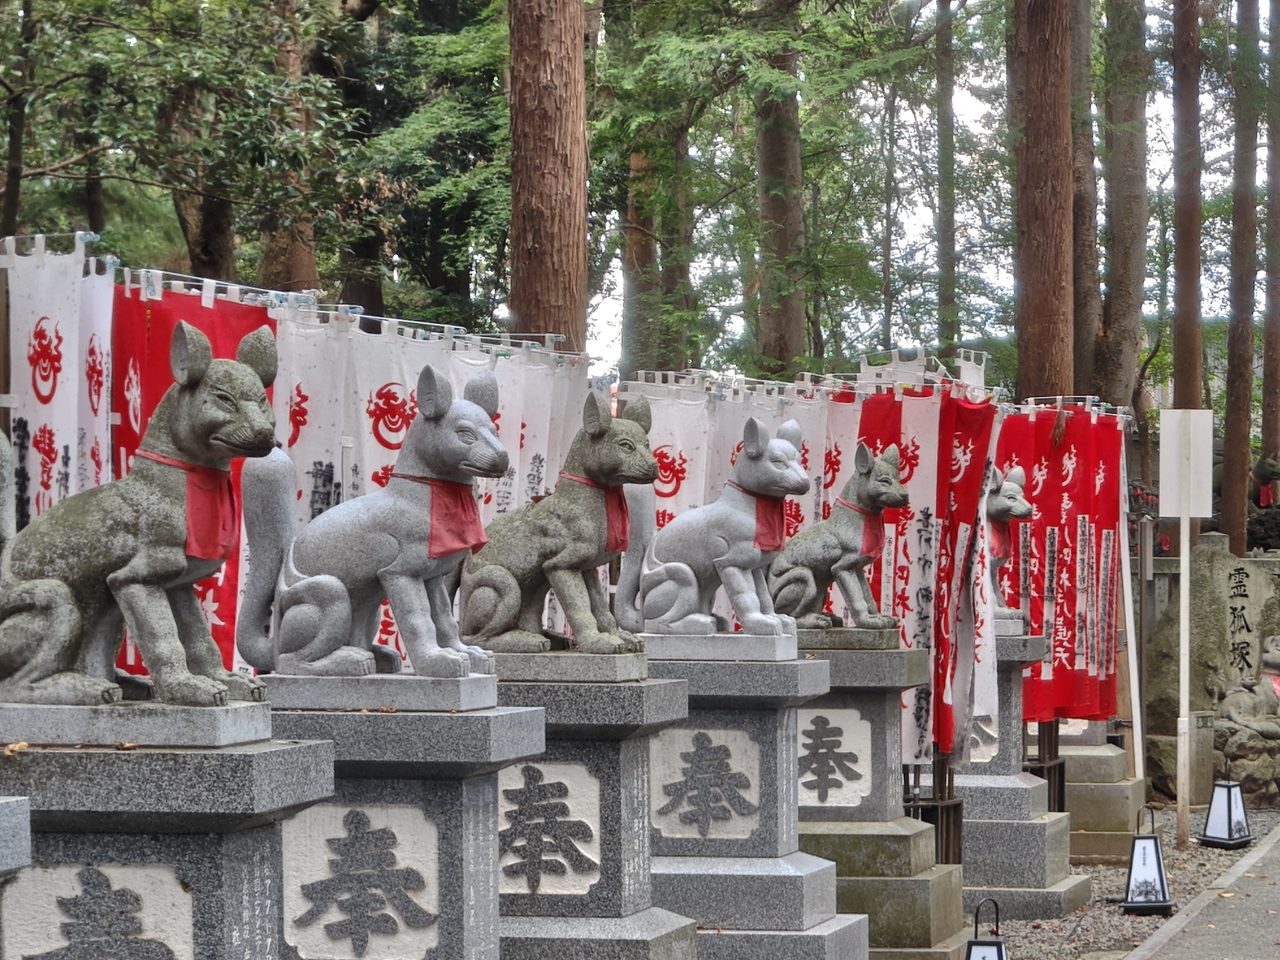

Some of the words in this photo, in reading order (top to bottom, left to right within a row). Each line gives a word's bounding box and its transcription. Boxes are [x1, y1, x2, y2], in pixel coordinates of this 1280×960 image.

[1228, 567, 1252, 673] 霊狐塚
[656, 732, 759, 838] 奉
[799, 716, 863, 801] 奉
[294, 808, 439, 956] 奉
[499, 765, 600, 893] 奉
